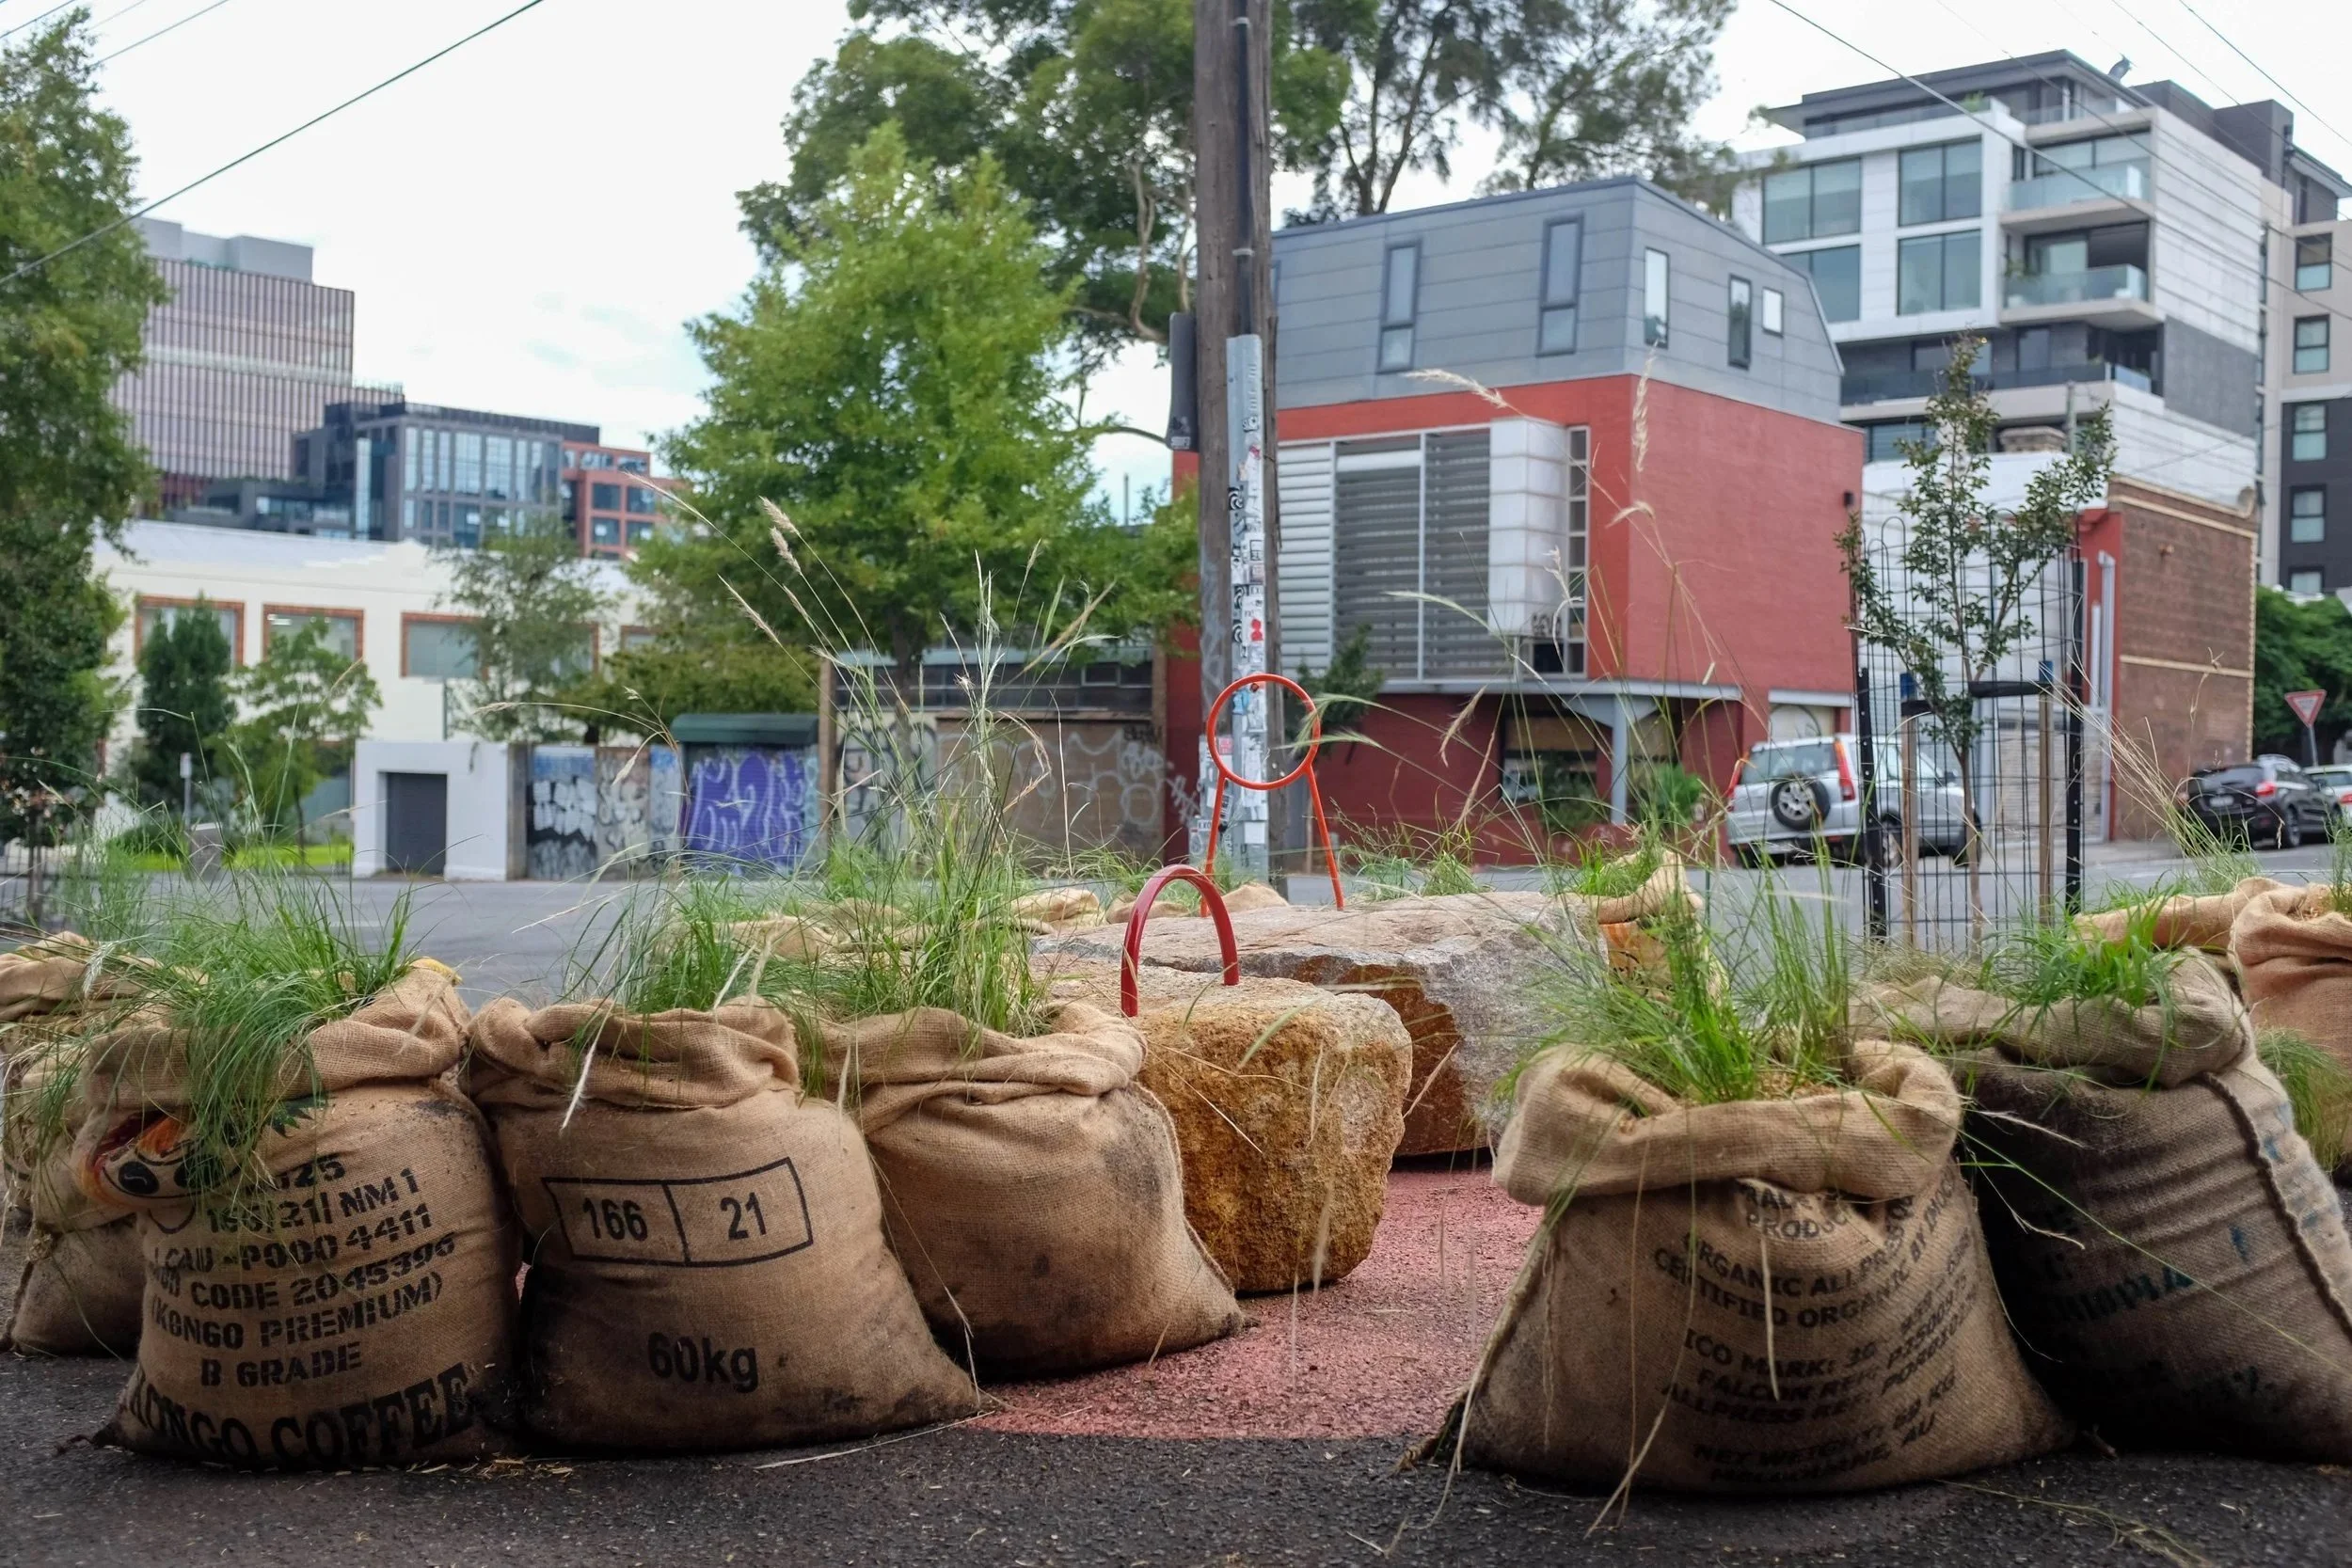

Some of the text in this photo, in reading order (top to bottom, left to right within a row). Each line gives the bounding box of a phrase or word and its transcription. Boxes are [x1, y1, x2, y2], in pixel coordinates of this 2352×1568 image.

[583, 1192, 767, 1242] 166 21
[191, 1279, 279, 1310] CODE
[290, 1232, 455, 1307] 2045396
[260, 1272, 443, 1347] PREMIUM)
[200, 1340, 362, 1387] B GRADE
[647, 1332, 759, 1393] 60kg
